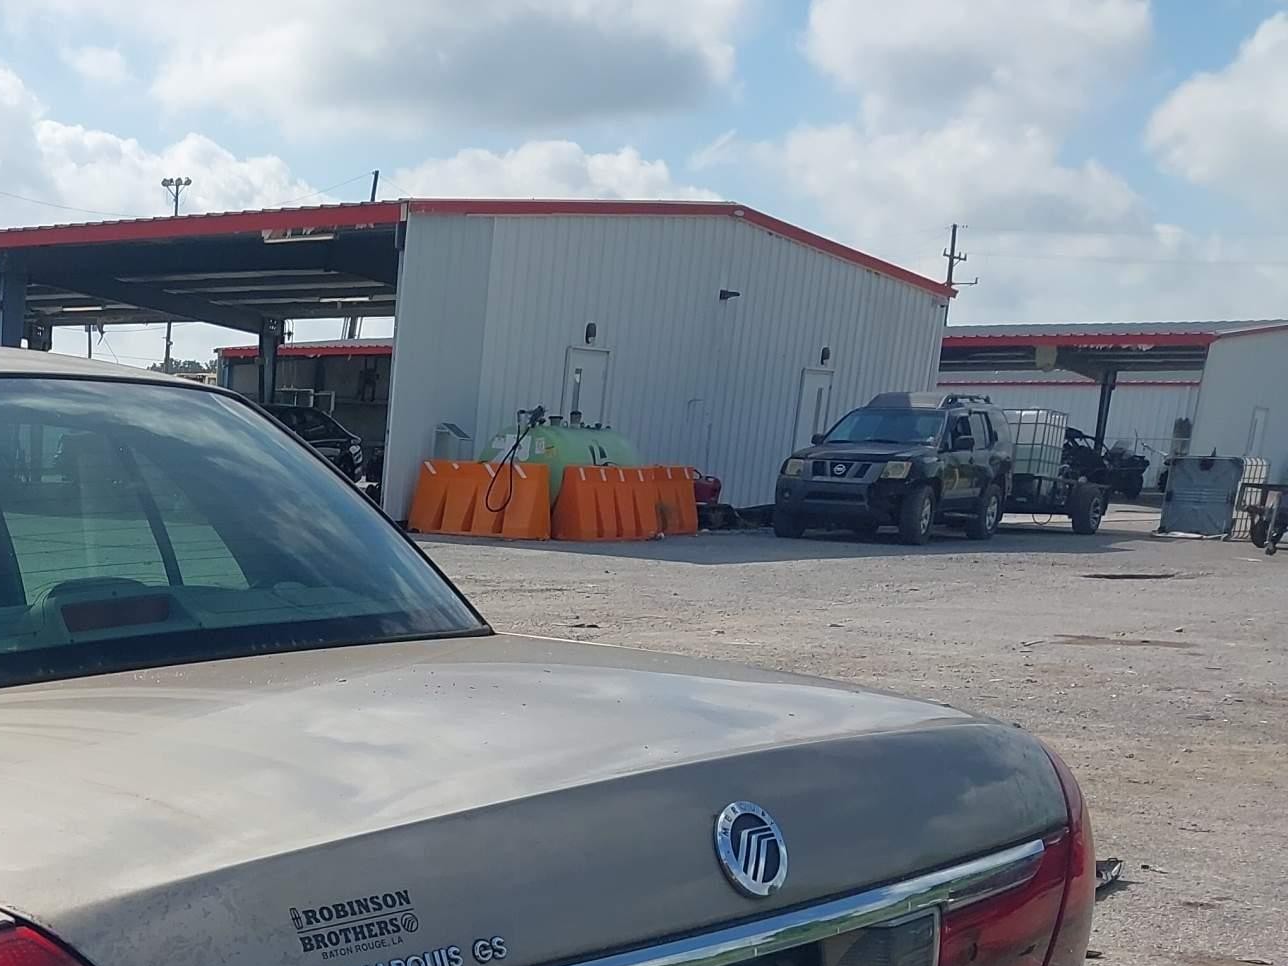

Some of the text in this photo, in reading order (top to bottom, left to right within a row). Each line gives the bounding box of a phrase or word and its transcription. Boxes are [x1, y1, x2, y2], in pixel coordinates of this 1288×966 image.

[302, 890, 411, 925] ROBINSON
[299, 918, 401, 952] BROTHERS
[322, 947, 353, 960] BATON
[392, 936, 404, 945] LA
[472, 936, 508, 963] GS
